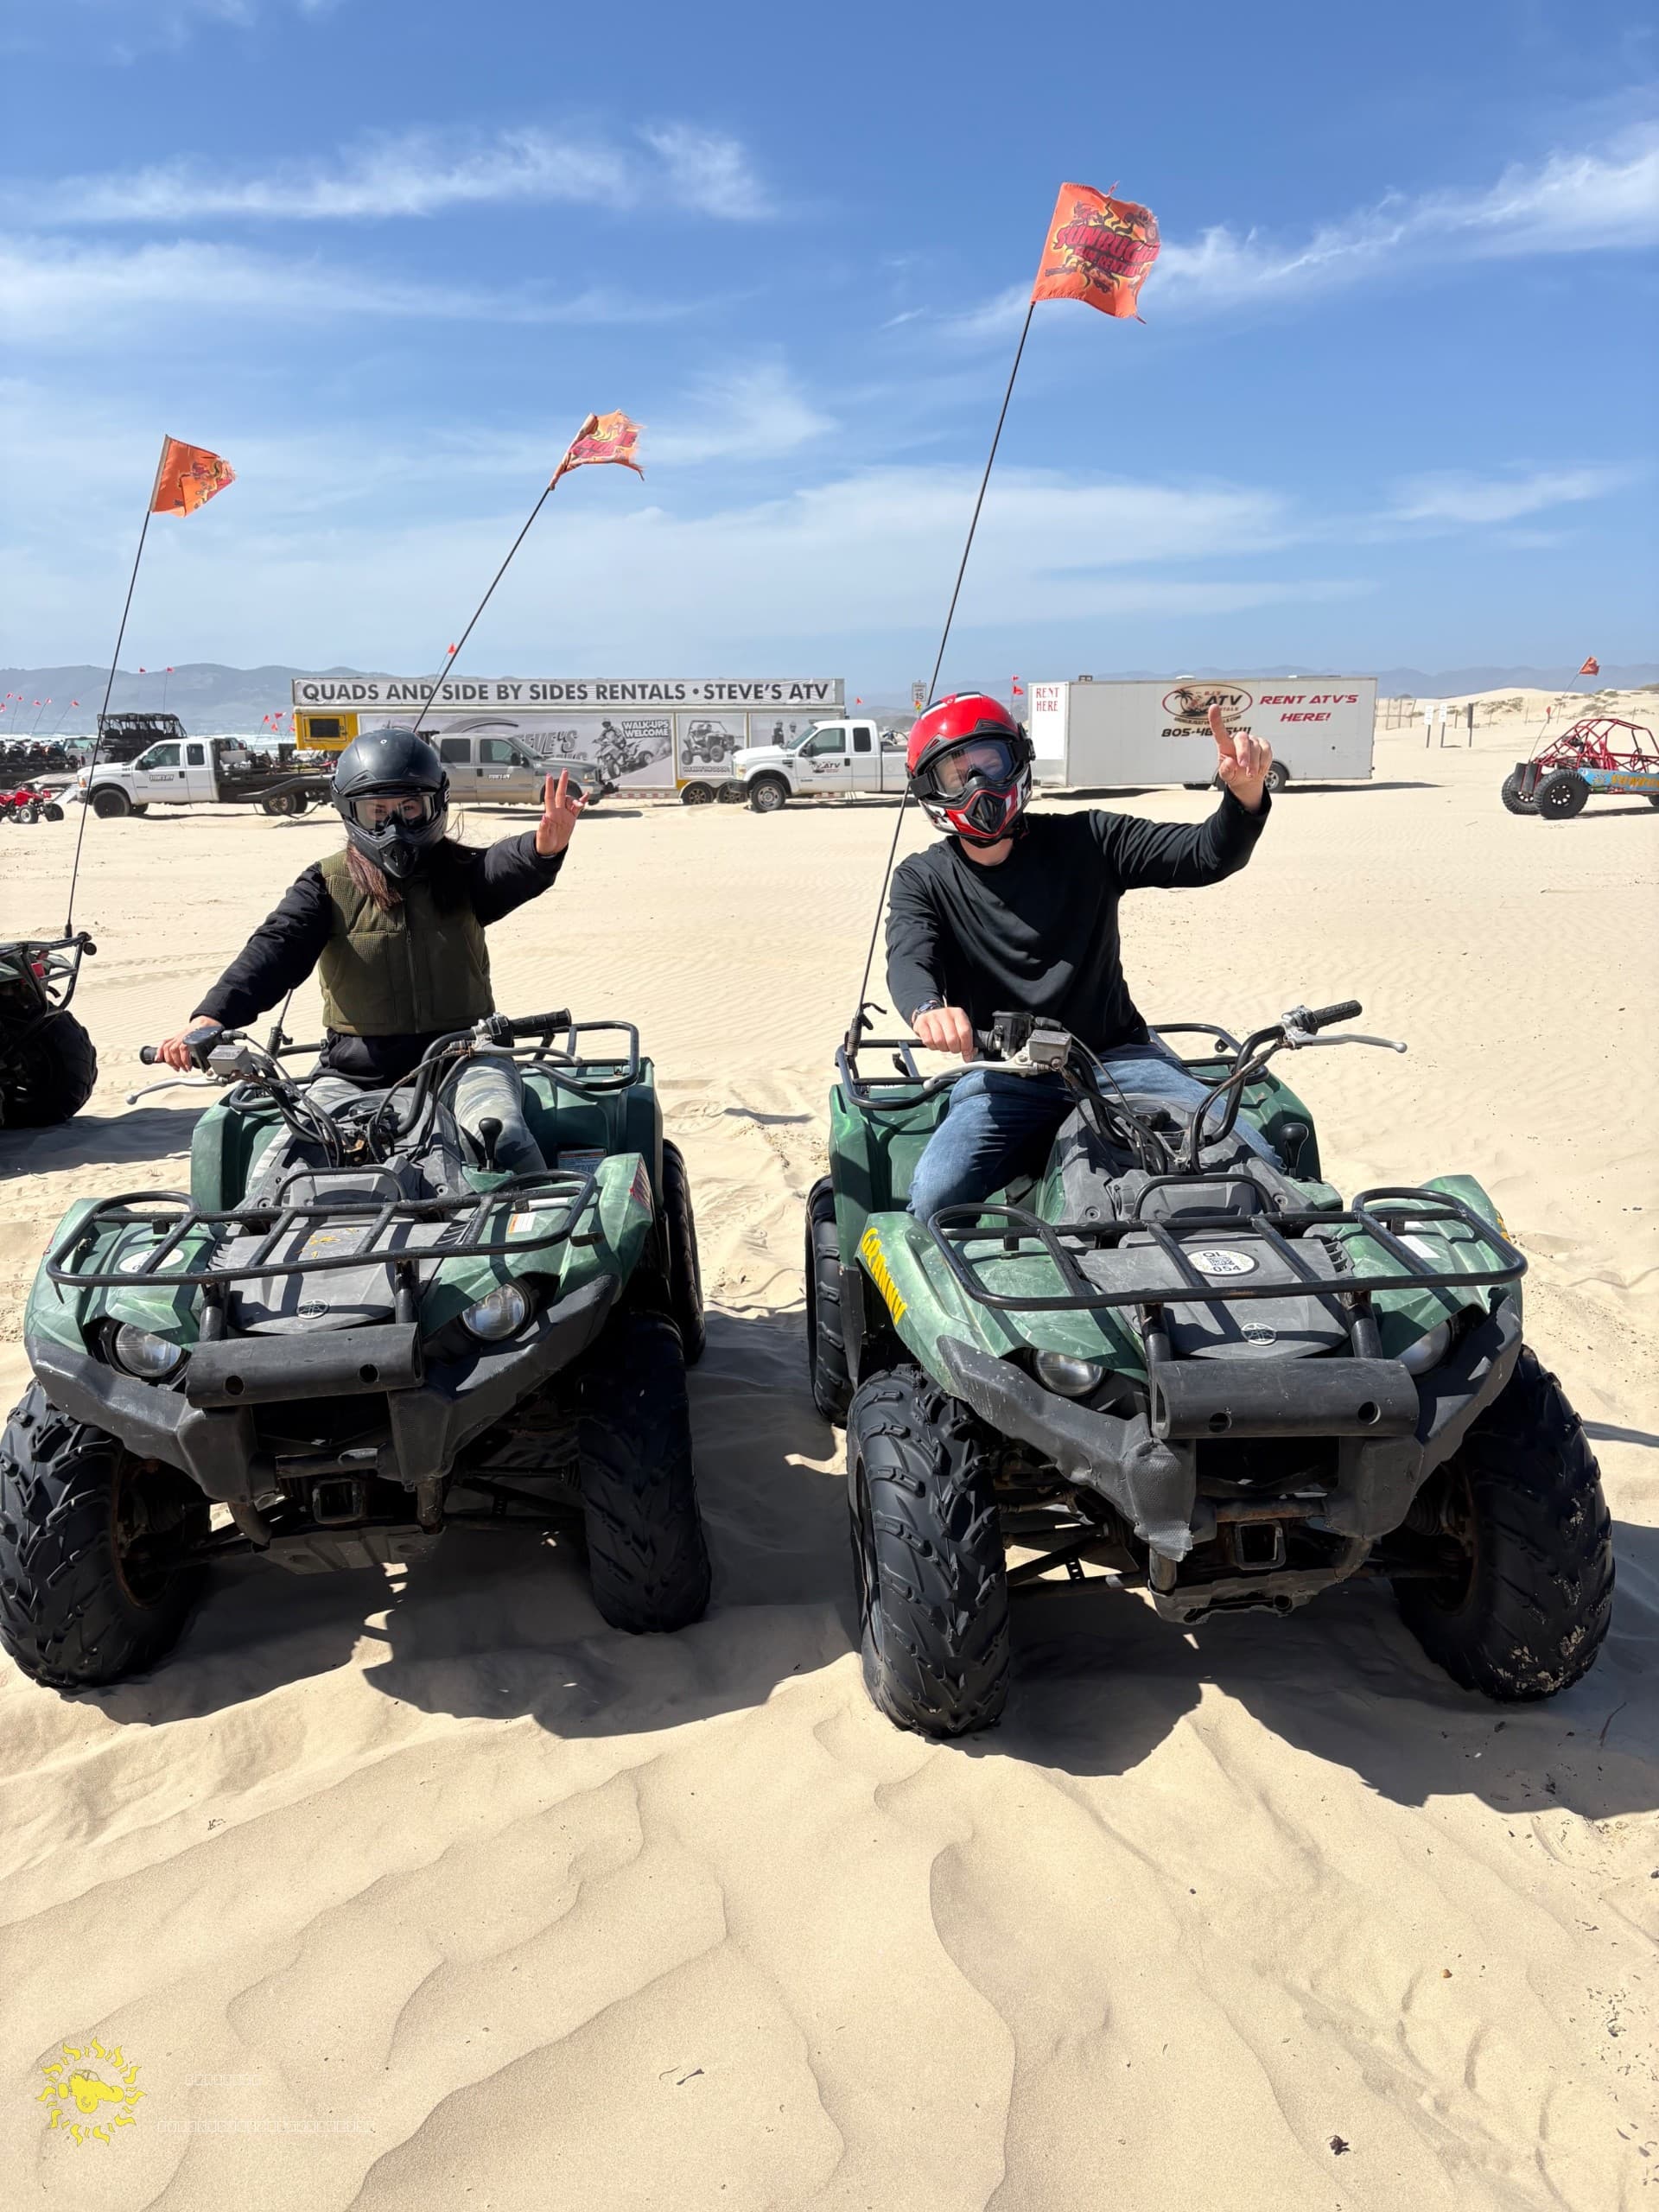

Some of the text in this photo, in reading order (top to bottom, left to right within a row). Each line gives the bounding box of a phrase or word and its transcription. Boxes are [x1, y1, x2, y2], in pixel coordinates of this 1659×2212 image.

[302, 683, 829, 701] QUADS AND SIDE BY SIDES RENTALS STEVE'S ATV
[1036, 687, 1059, 698] RENT
[1205, 695, 1243, 706] ATV
[1260, 694, 1358, 705] RENT ATV'S
[1036, 700, 1058, 712] HERE
[1280, 712, 1332, 722] HERE!
[622, 720, 669, 729] WALK-UPS
[624, 728, 669, 738] WELCOME
